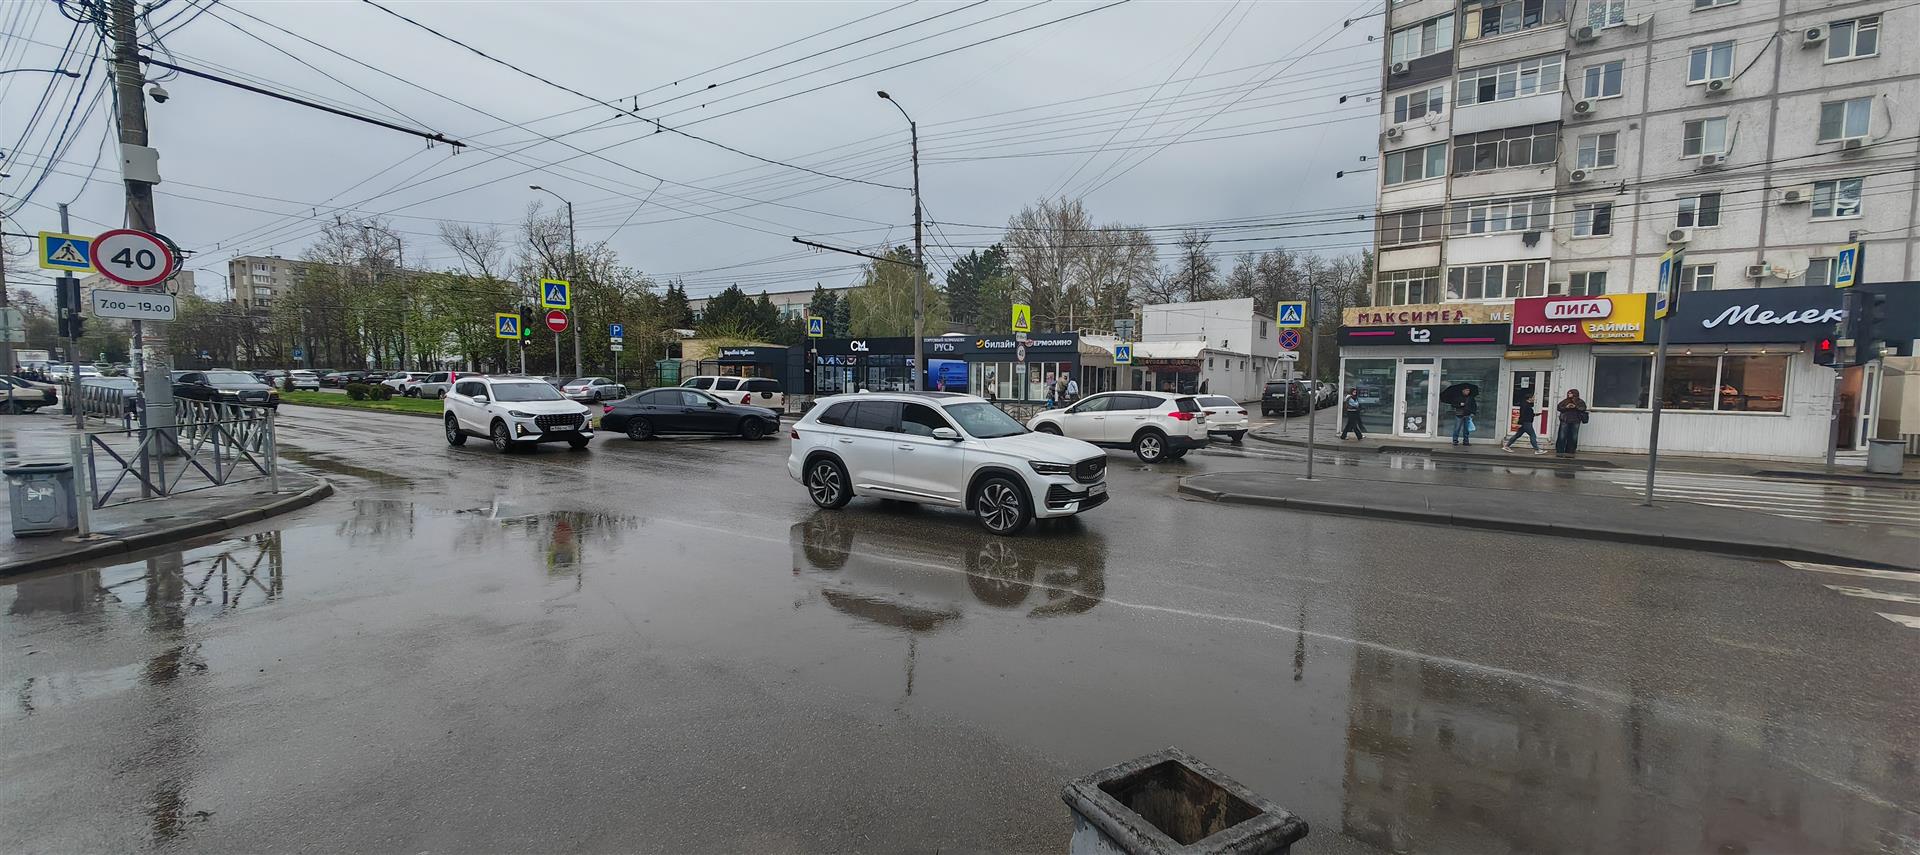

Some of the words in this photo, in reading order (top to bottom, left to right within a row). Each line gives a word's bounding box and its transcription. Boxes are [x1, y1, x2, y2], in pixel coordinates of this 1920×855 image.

[111, 247, 156, 270] 40
[1554, 303, 1601, 315] ЛИГА
[1358, 309, 1464, 325] МАКСИМЕД
[1490, 312, 1511, 321] МЕ
[1701, 304, 1848, 329] Мелек
[613, 325, 621, 335] P
[1516, 324, 1577, 334] ЛОМБАРД
[1588, 321, 1640, 332] ЗАЙМЫ
[1410, 327, 1431, 343] t2
[934, 343, 955, 352] РУСЬ
[984, 339, 1016, 349] билайн
[1033, 339, 1073, 347] ЕРМОЛИНО
